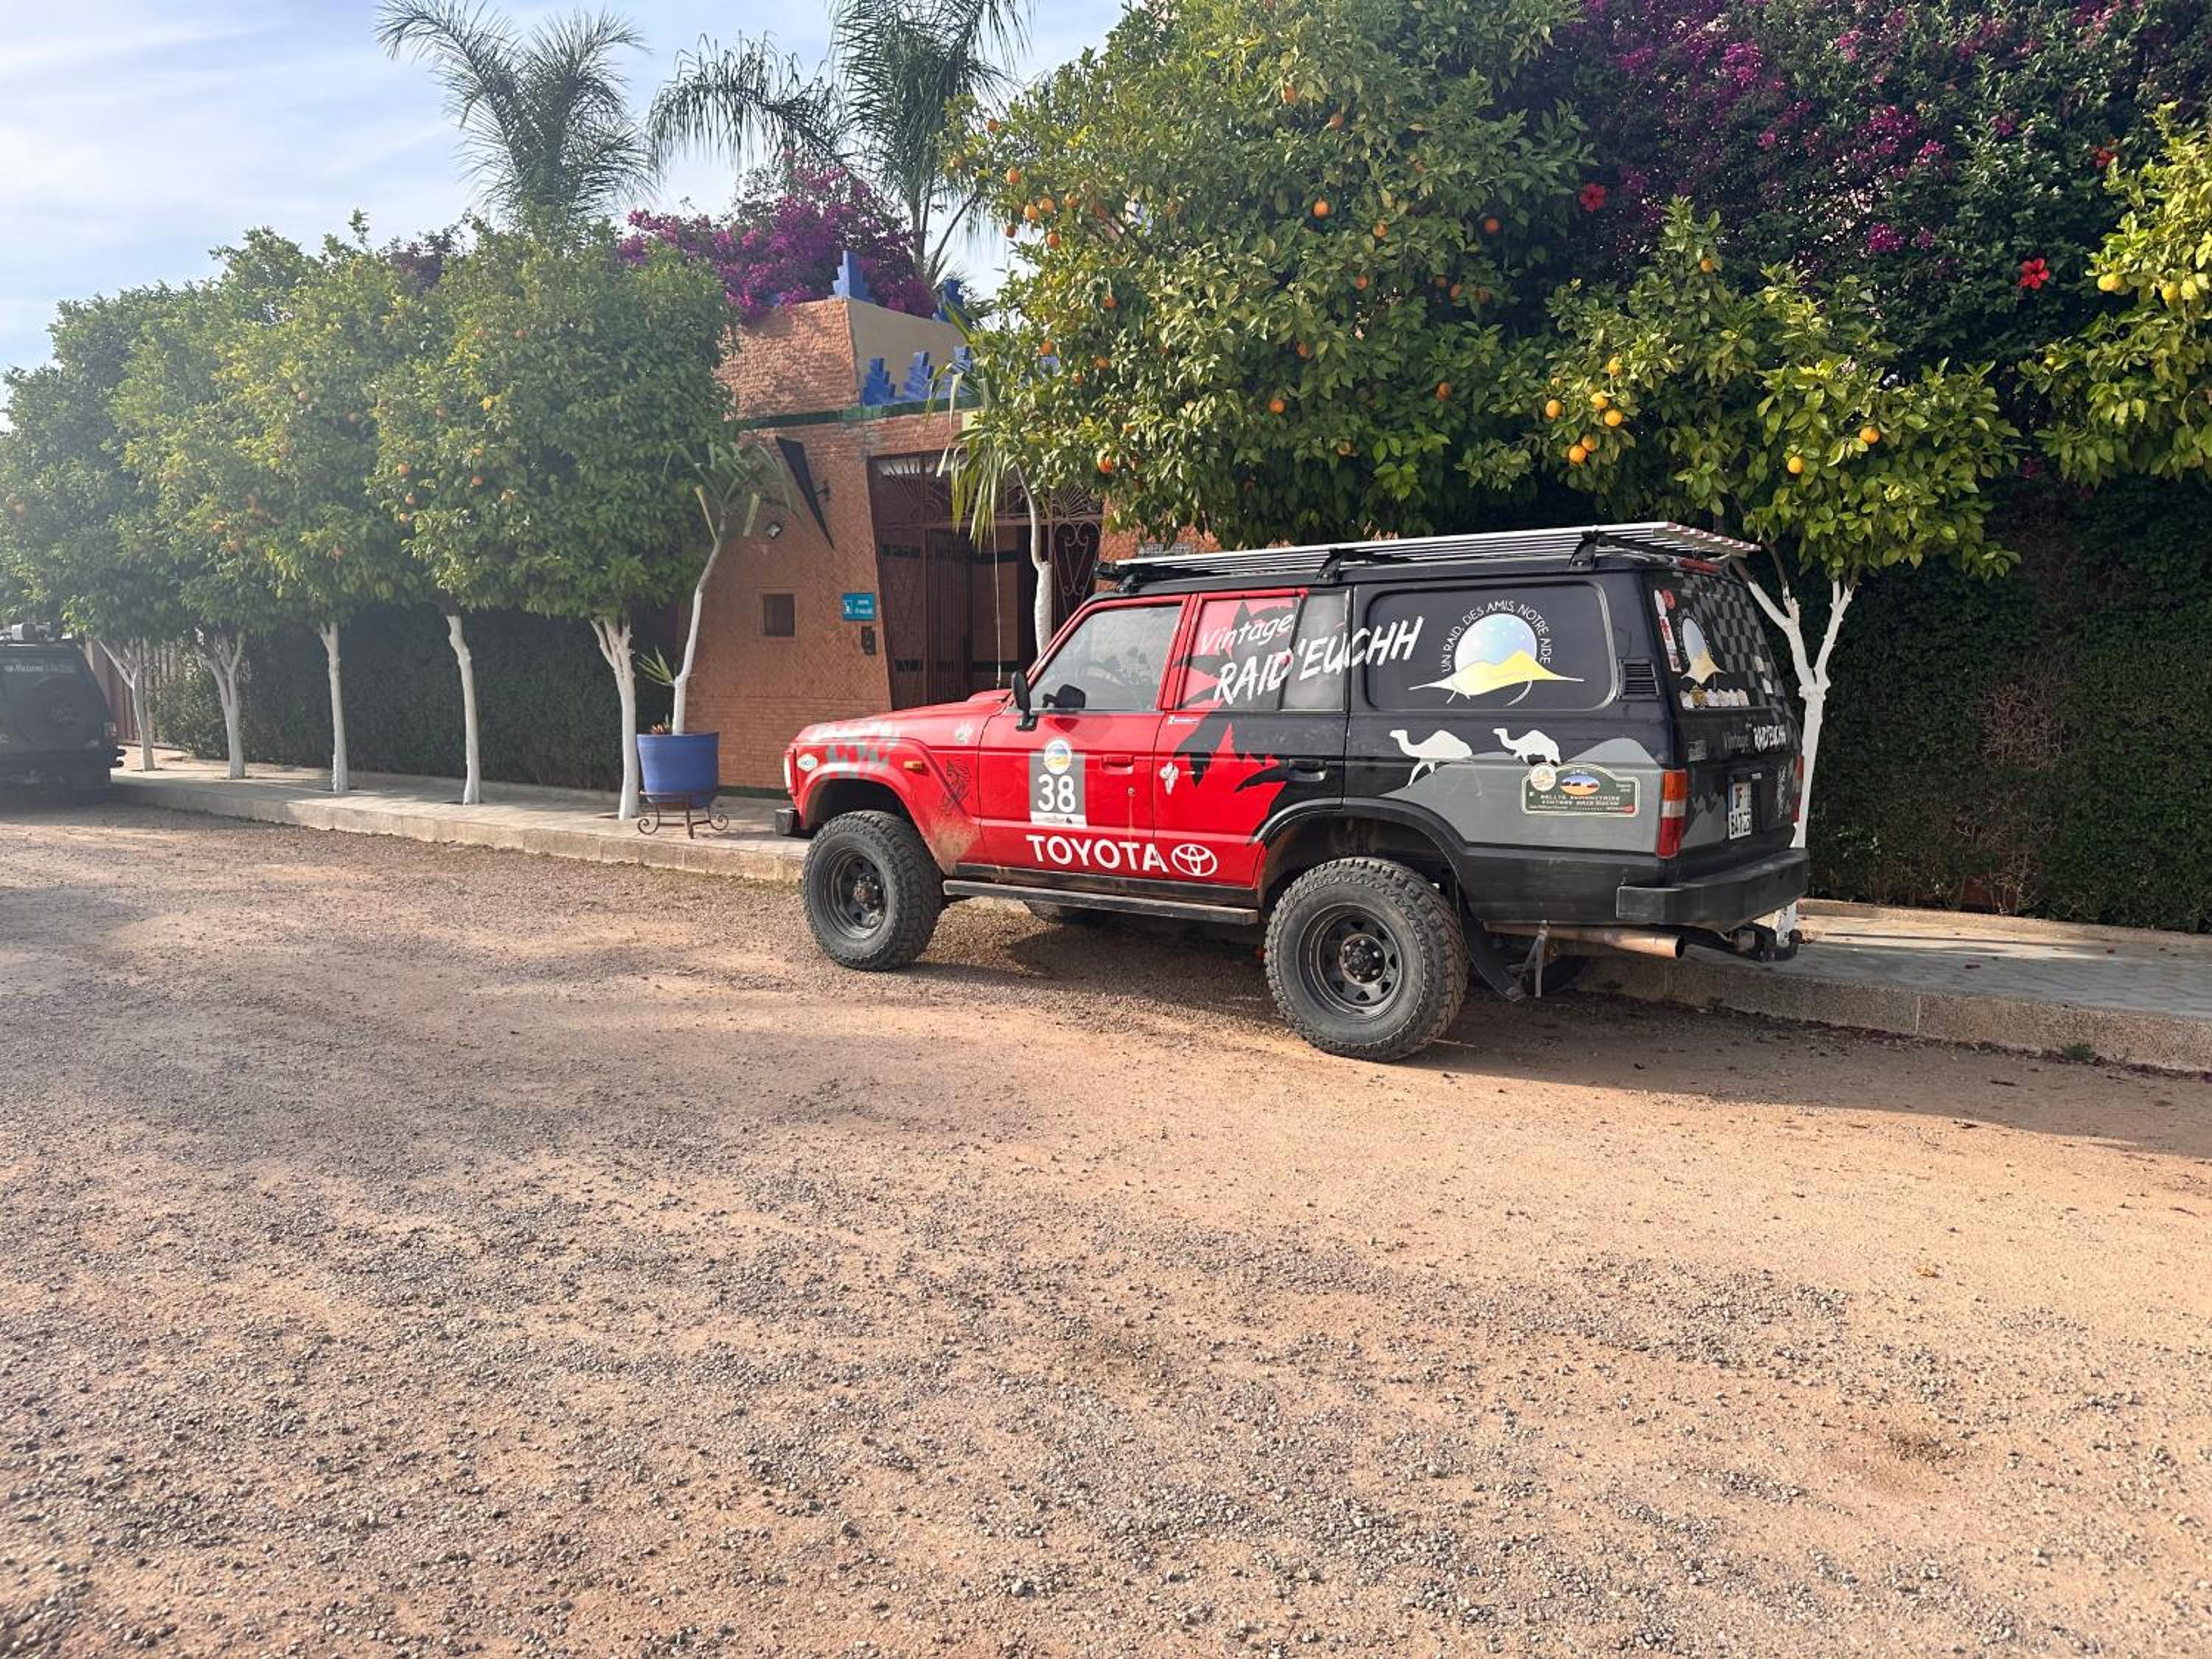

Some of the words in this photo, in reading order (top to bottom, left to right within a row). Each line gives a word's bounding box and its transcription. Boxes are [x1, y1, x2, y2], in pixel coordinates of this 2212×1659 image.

[1462, 605, 1484, 625] DES
[1517, 603, 1549, 636] NOTRE
[1200, 613, 1295, 655] Vintage
[1443, 625, 1465, 651] RAID,
[1539, 637, 1552, 664] AIDE
[1213, 615, 1425, 706] RAID'EUCHH
[1441, 653, 1452, 673] UN
[1037, 773, 1076, 813] 38
[1026, 834, 1170, 874] TOYOTA
